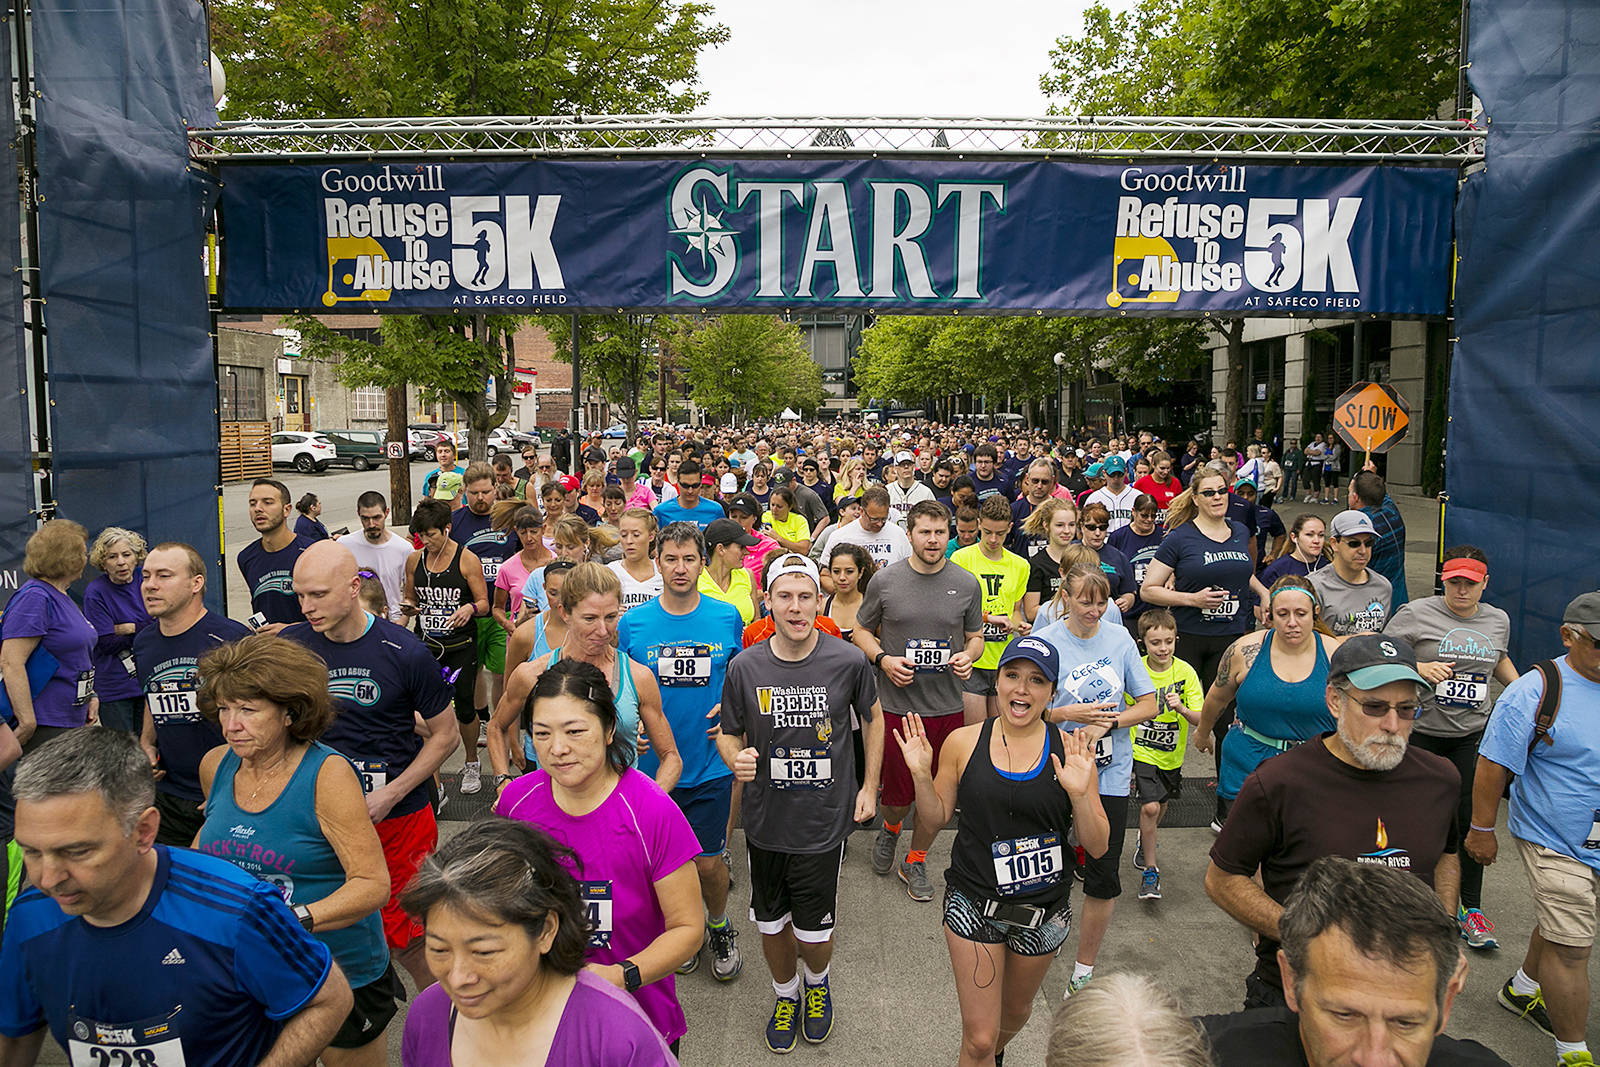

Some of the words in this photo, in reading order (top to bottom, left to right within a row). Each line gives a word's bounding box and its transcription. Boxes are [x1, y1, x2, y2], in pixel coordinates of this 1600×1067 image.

[321, 165, 446, 192] Goodwill
[1119, 164, 1246, 193] Goodwill
[325, 197, 449, 239] Refuse
[1117, 196, 1244, 239] Refuse
[667, 162, 1007, 302] START
[403, 235, 429, 262] To
[450, 195, 565, 291] 5K
[1194, 236, 1220, 263] To
[1243, 198, 1362, 293] 5K
[353, 255, 450, 290] Abuse
[1140, 255, 1243, 291] Abuse
[453, 295, 469, 304] AT
[474, 295, 526, 305] SAFECO
[531, 295, 567, 305] FIELD
[1244, 297, 1263, 307] AT
[1267, 297, 1320, 308] SAFECO
[1325, 297, 1361, 308] FIELD
[1345, 403, 1397, 431] SLOW
[1203, 551, 1249, 566] MARINERS
[484, 564, 497, 575] 66
[0, 570, 18, 589] N
[622, 593, 654, 603] ARIN
[425, 616, 446, 629] 562
[674, 659, 696, 676] 98
[914, 651, 942, 665] 589
[338, 668, 347, 677] TO
[348, 667, 371, 677] ABUSE
[1072, 656, 1112, 681] REFUSE
[357, 684, 375, 700] 5K
[773, 686, 826, 696] Washington
[1089, 679, 1104, 689] TO
[1446, 682, 1477, 699] 326
[156, 694, 190, 713] 1175
[772, 694, 828, 713] BEER
[773, 712, 812, 729] Run
[1142, 729, 1175, 744] 1023
[784, 761, 818, 779] 134
[1005, 850, 1054, 881] 1015
[1387, 856, 1411, 867] RIVER
[586, 902, 601, 931] 4
